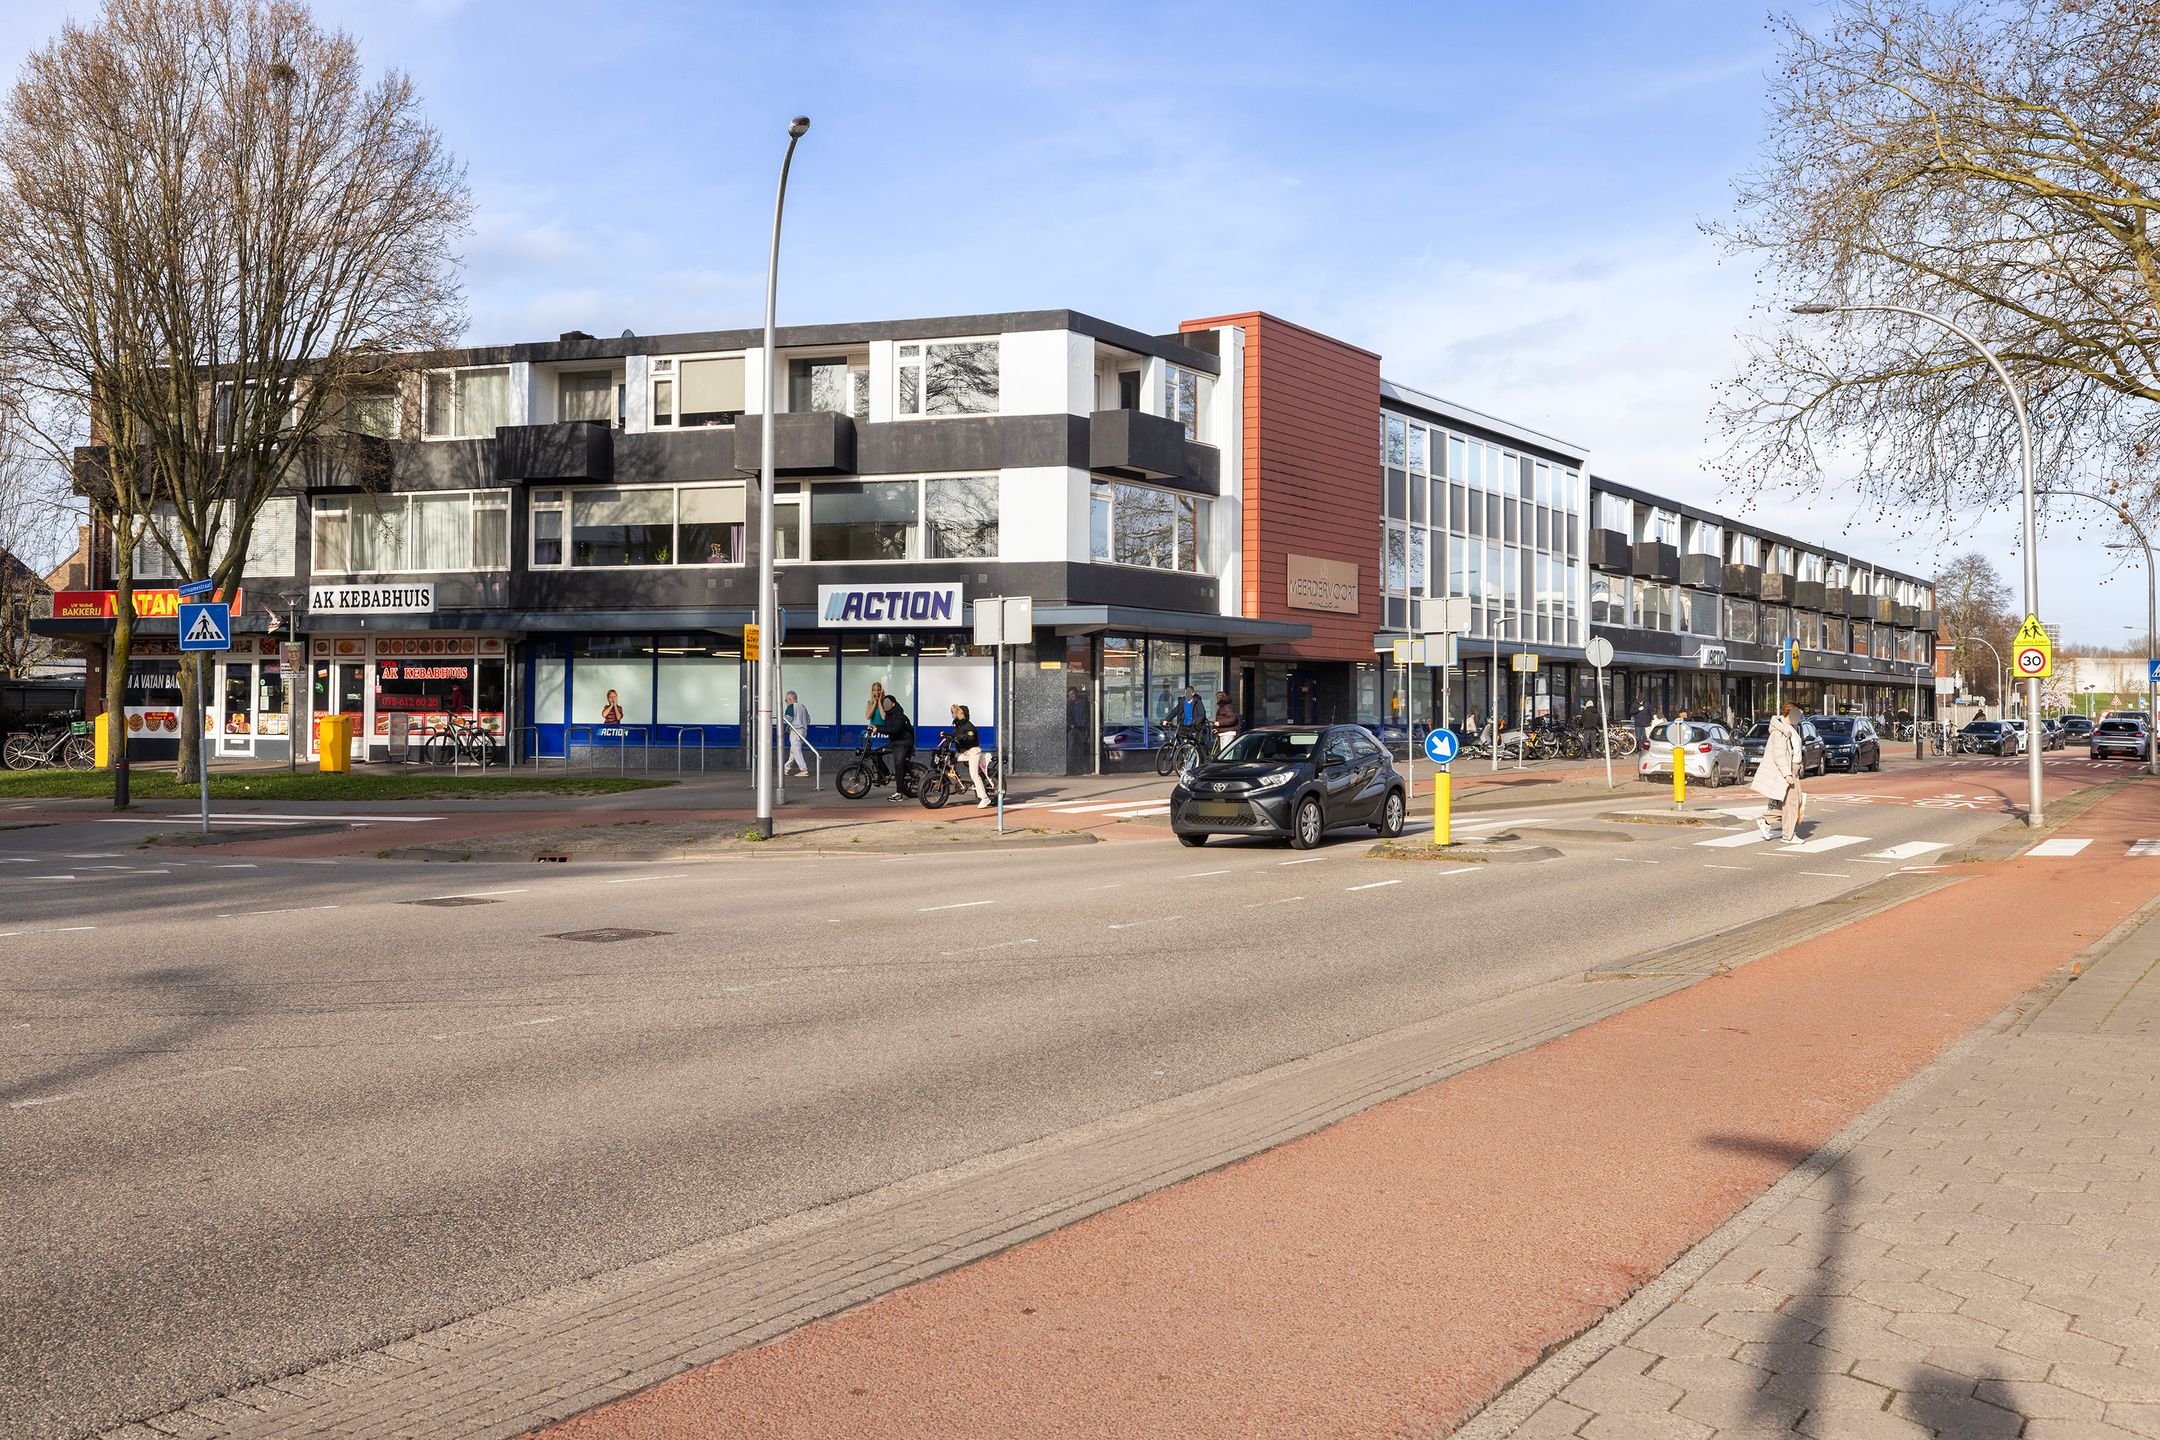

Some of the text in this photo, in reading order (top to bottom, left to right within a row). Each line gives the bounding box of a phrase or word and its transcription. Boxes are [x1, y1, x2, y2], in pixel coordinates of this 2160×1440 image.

[179, 582, 211, 595] Surinamestraat
[1290, 578, 1356, 600] MEERDERVOORT
[312, 588, 430, 608] AK KEBABHUIS
[62, 607, 102, 616] BAKKERIJ
[841, 590, 954, 620] ACTION
[2023, 656, 2042, 666] 30
[381, 666, 468, 679] AK KEBABHUIS
[141, 675, 165, 688] VATAN
